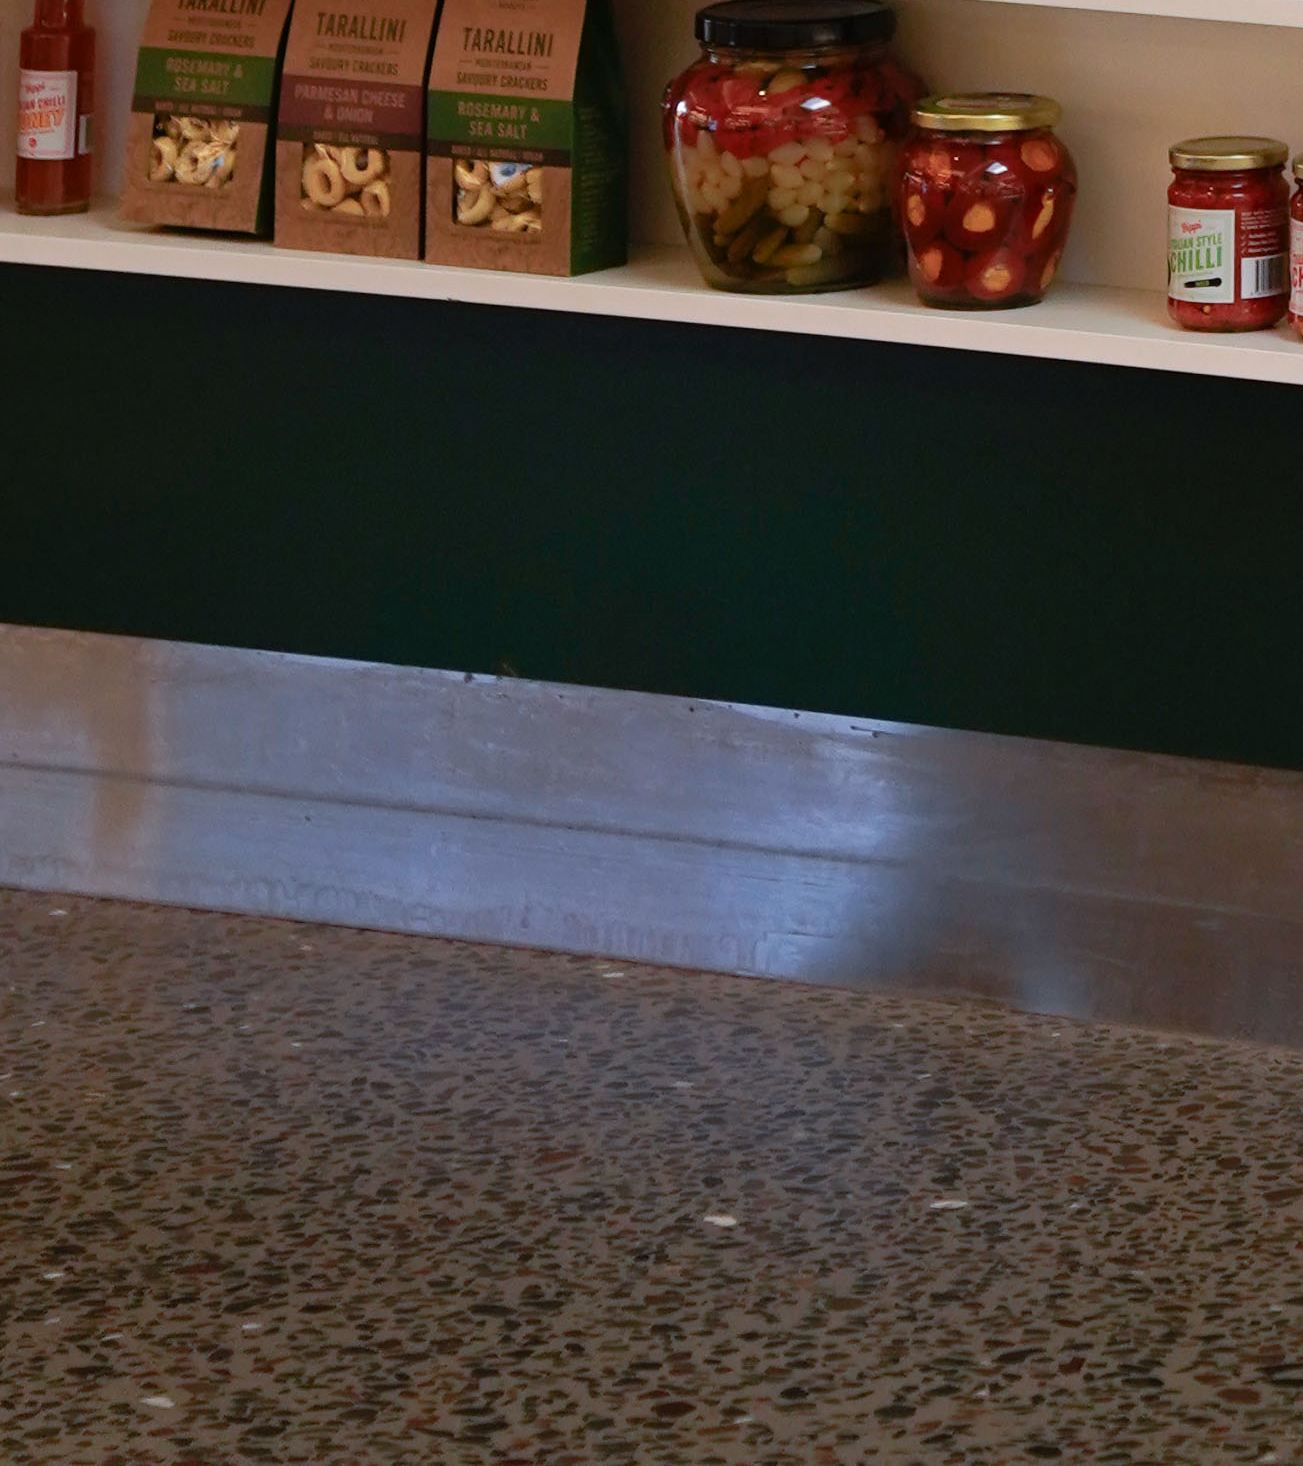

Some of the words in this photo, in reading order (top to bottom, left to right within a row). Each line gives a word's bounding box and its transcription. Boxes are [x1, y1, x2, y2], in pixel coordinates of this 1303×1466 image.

[314, 11, 408, 44] TARALLINI
[462, 27, 554, 58] TARALLINI
[457, 100, 526, 121] ROSEMARY
[469, 120, 493, 137] SEA
[497, 122, 528, 140] SALT
[1195, 232, 1223, 248] STYLE
[1170, 246, 1223, 274] CHILLI
